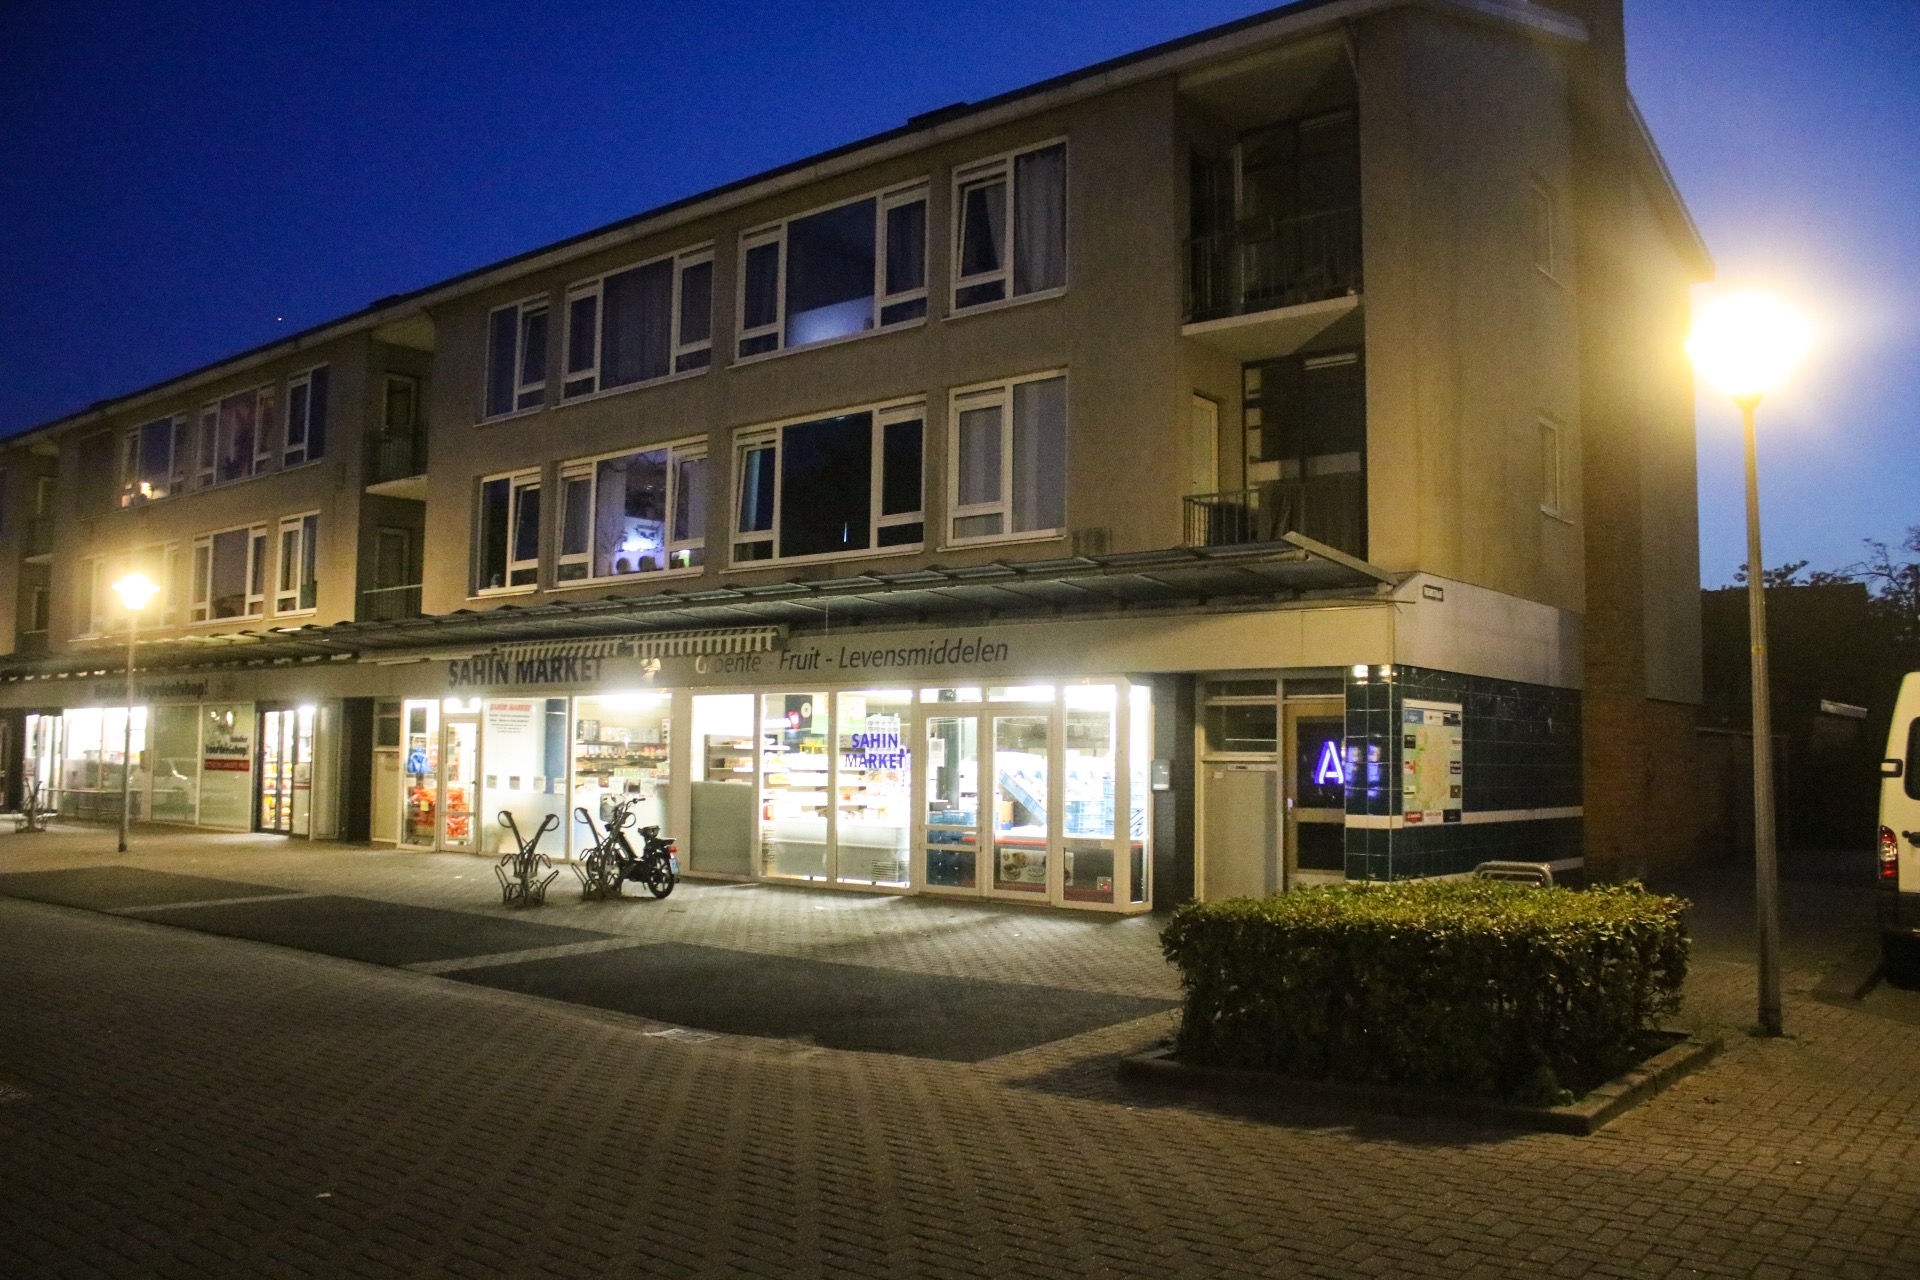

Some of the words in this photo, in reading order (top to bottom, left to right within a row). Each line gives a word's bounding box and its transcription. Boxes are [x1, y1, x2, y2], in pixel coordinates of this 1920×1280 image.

[780, 646, 821, 671] Fruit
[839, 636, 1009, 669] Levensmiddelen
[516, 656, 603, 684] MARKET
[844, 753, 905, 769] MARKET
